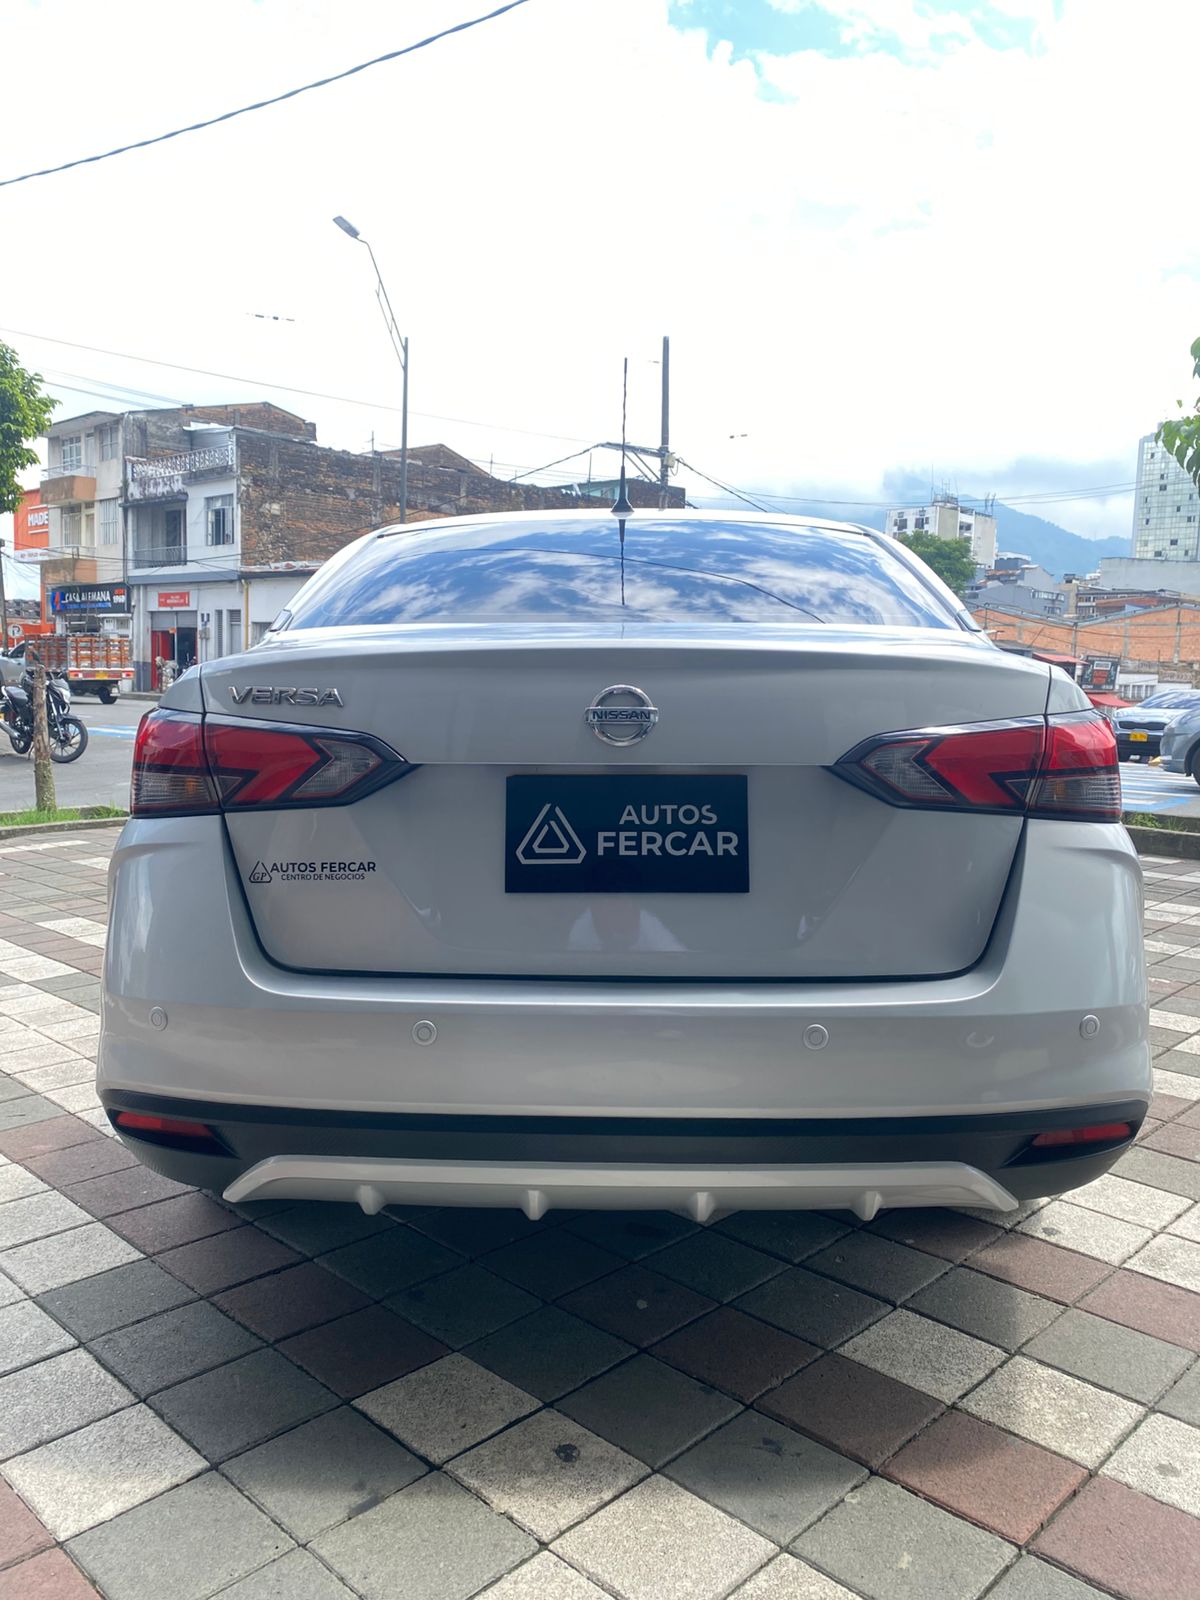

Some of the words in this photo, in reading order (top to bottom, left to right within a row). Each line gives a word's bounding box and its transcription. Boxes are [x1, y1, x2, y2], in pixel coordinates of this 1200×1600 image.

[64, 591, 81, 603] CASA
[81, 590, 111, 602] ALEMANA
[228, 686, 344, 707] VERSA
[592, 710, 651, 720] NISSAN
[618, 804, 718, 825] AUTOS
[597, 831, 739, 856] FERCAR
[270, 862, 317, 873] AUTOS
[320, 861, 376, 873] FERCAR
[281, 873, 312, 881] CENTRO
[313, 873, 324, 881] DE
[324, 872, 366, 881] NEGOCIOS
